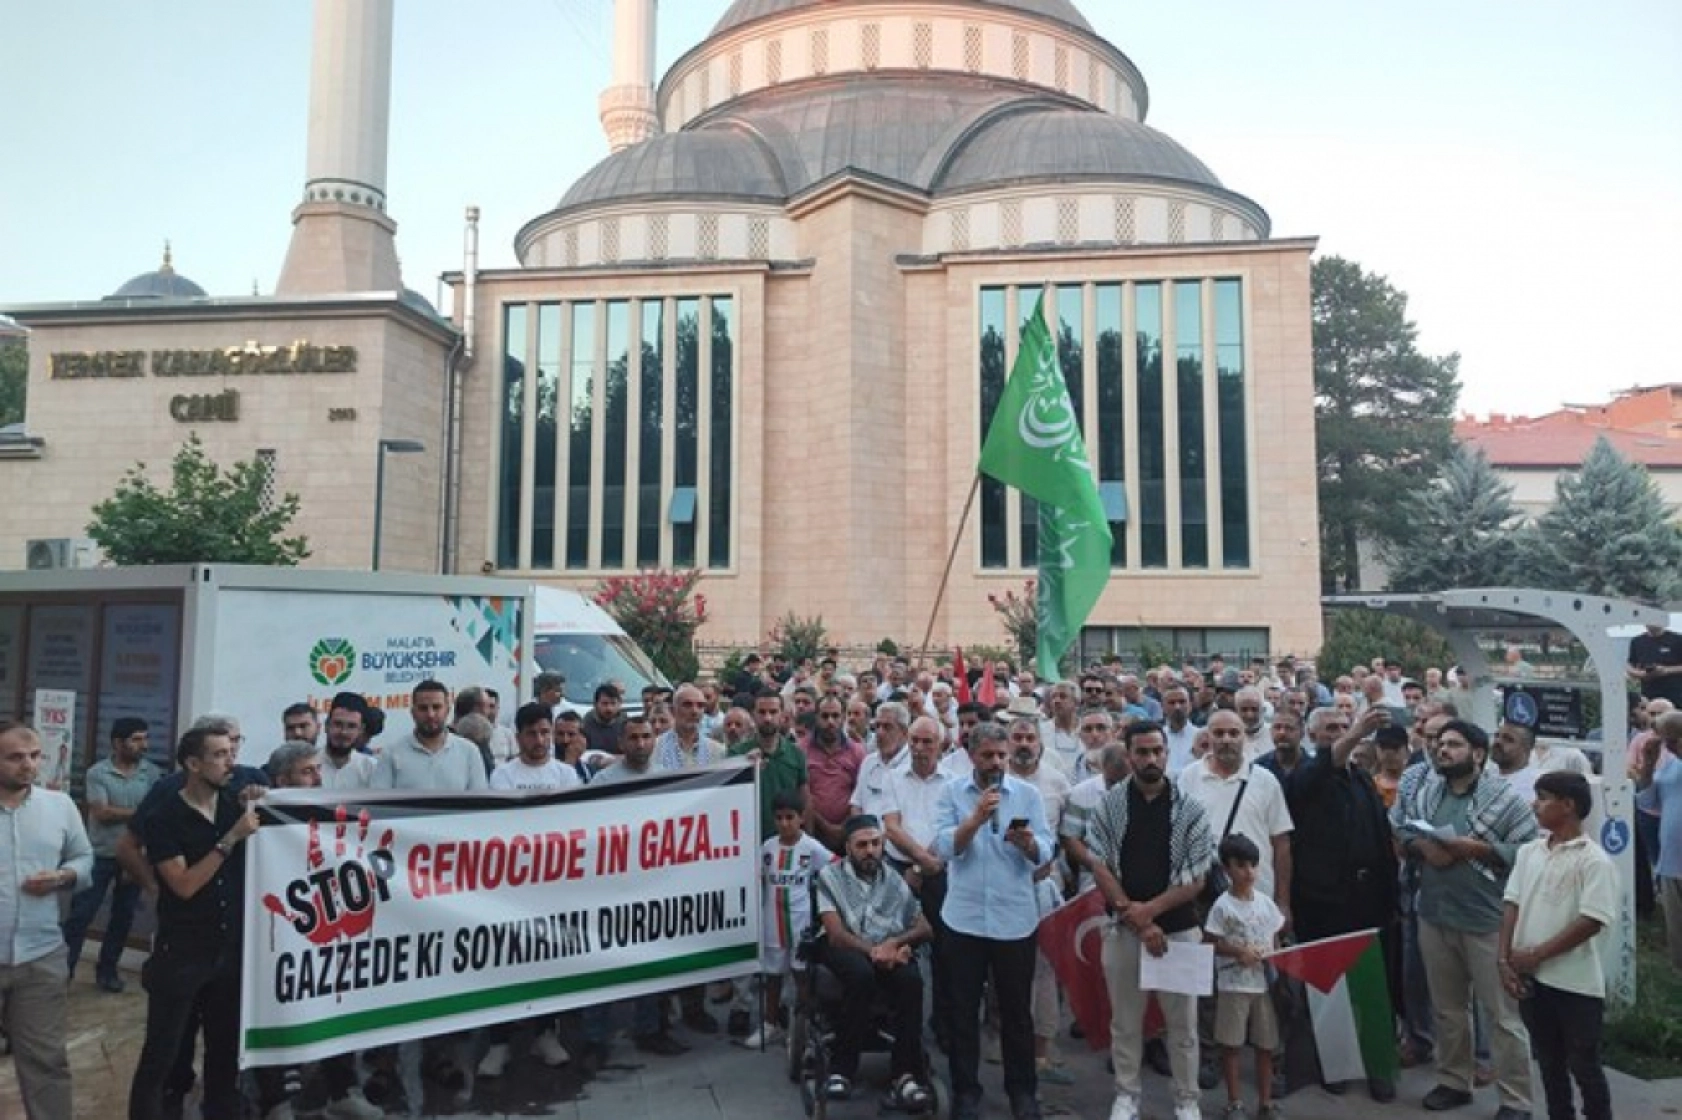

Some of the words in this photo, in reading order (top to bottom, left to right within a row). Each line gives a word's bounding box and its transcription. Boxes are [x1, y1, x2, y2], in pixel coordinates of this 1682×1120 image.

[386, 637, 435, 649] MALATYA
[286, 849, 395, 935] STOP
[407, 829, 586, 899] GENOCIDE
[595, 824, 630, 876] IN
[638, 809, 740, 871] GAZA..!
[275, 934, 411, 1004] GAZZEDE
[452, 909, 592, 974] SOYKIRIMI
[598, 886, 747, 948] DURDURUN..!
